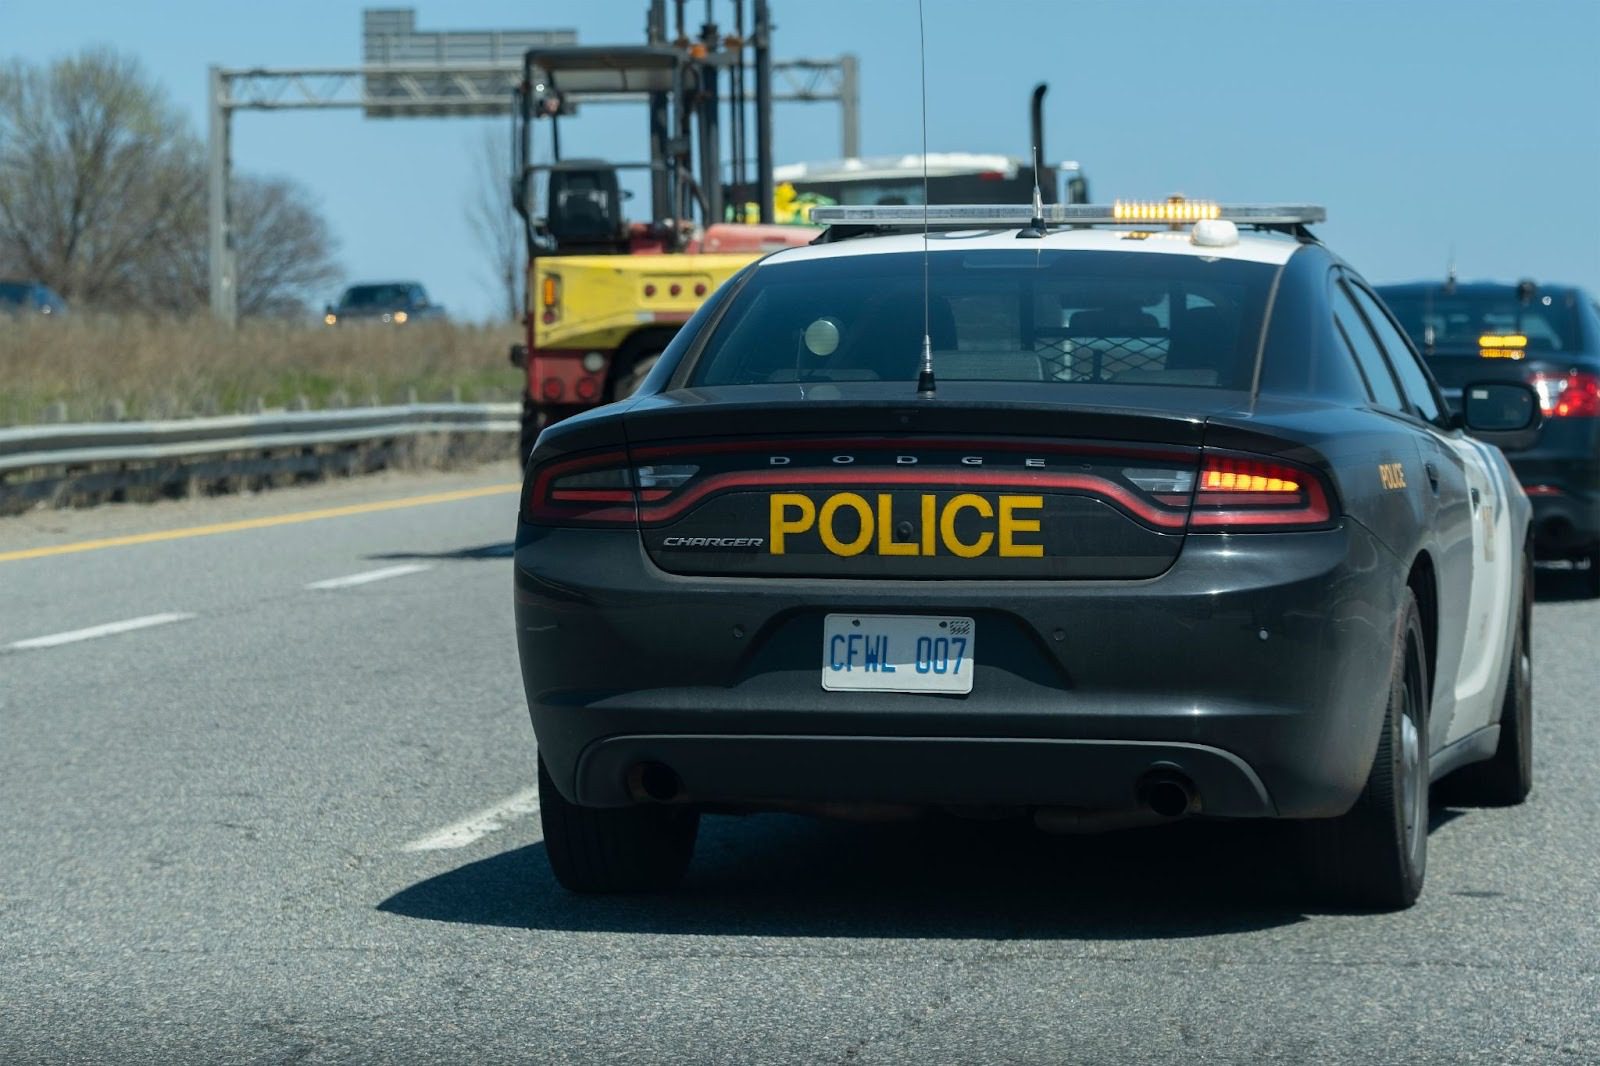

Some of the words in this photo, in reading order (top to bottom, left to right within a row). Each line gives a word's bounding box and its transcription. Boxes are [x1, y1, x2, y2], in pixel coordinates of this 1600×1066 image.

[769, 455, 1046, 467] DODGE
[1378, 463, 1407, 489] POLICE
[769, 492, 1044, 559] POLICE
[663, 536, 764, 548] CHARGER
[830, 634, 896, 673] CFWL
[915, 636, 967, 675] 007
